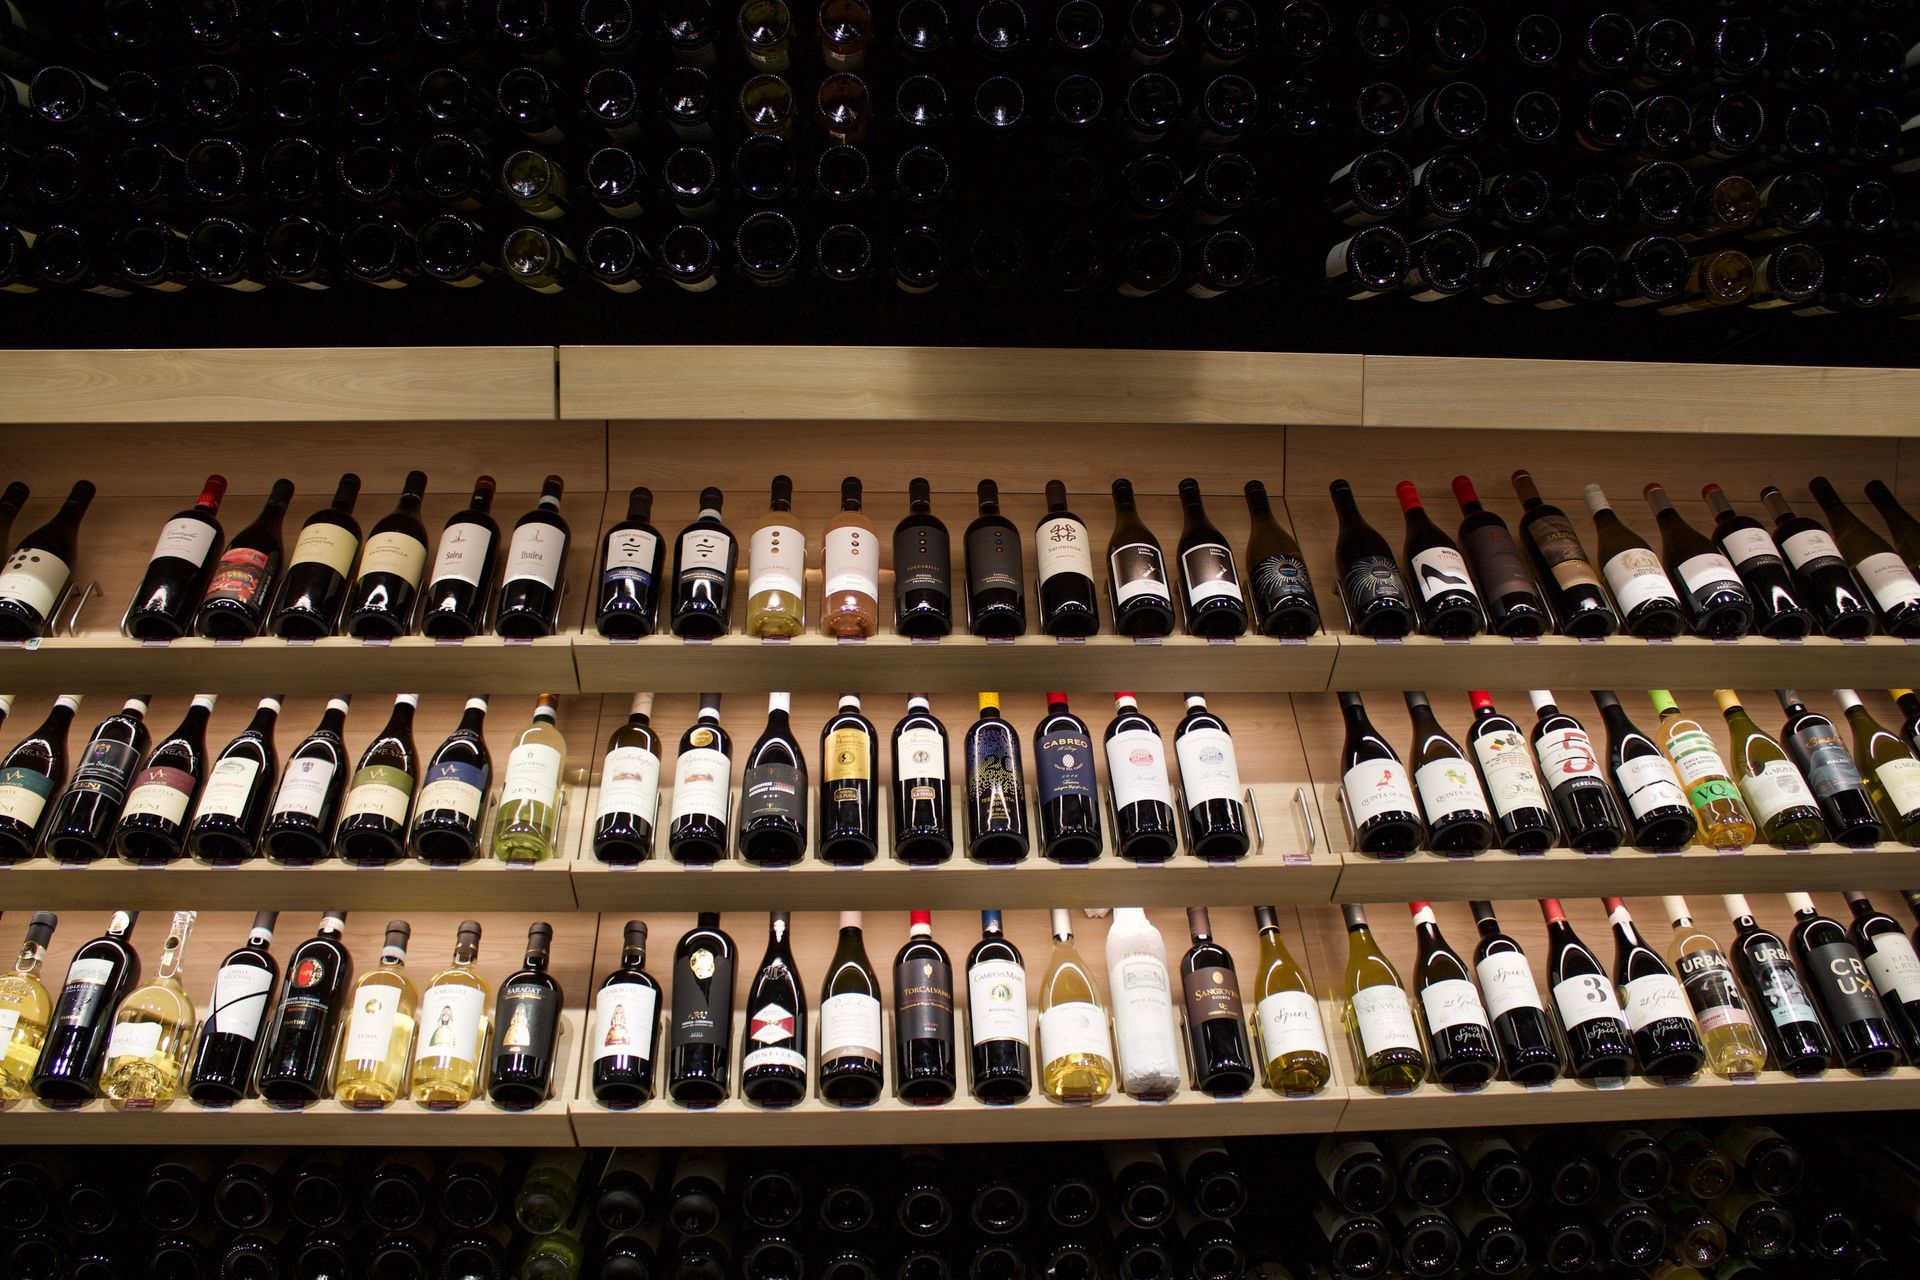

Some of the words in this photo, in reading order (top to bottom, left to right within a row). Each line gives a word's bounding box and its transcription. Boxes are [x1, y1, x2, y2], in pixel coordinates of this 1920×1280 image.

[445, 551, 463, 560] Solea
[1043, 738, 1089, 750] CABREO
[72, 782, 101, 791] ZENI
[1571, 780, 1603, 788] PERELADA
[1696, 783, 1729, 800] VQ
[1361, 793, 1389, 806] QUINTA
[1436, 789, 1464, 803] QUINTA
[1830, 957, 1867, 976] CR
[1493, 967, 1530, 982] Spier
[1583, 976, 1607, 1003] 3
[1837, 976, 1877, 995] UX
[1587, 1024, 1623, 1039] Spier
[1652, 1022, 1686, 1037] Spier
